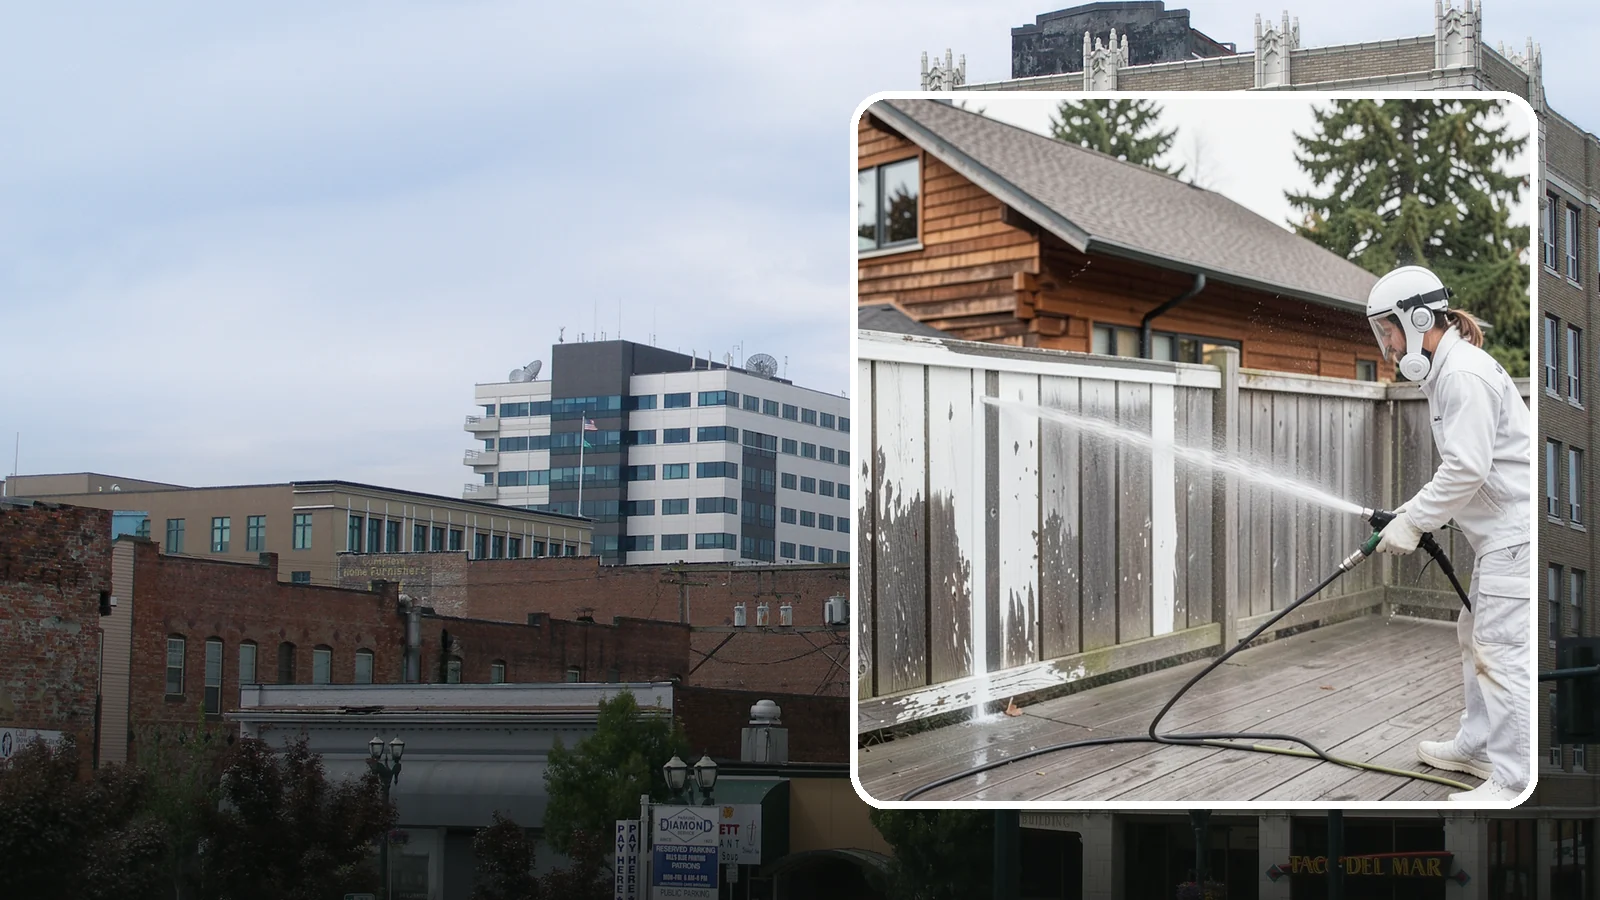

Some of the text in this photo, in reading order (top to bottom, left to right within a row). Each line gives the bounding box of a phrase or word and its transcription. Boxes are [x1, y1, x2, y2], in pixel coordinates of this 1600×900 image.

[343, 565, 427, 577] Home Furnishers
[660, 818, 713, 832] DIAMOND
[1022, 815, 1070, 828] BUILDING
[719, 824, 740, 835] ETT
[719, 839, 740, 848] ANT
[656, 845, 716, 854] RESERVED PARKING
[616, 825, 625, 894] PAY HERE
[627, 824, 637, 893] PAY HERE
[721, 851, 739, 862] Soup
[671, 862, 701, 870] PATRONS
[1289, 855, 1442, 877] TAC DEL MAR
[660, 888, 710, 899] PUBLIC PARKING
